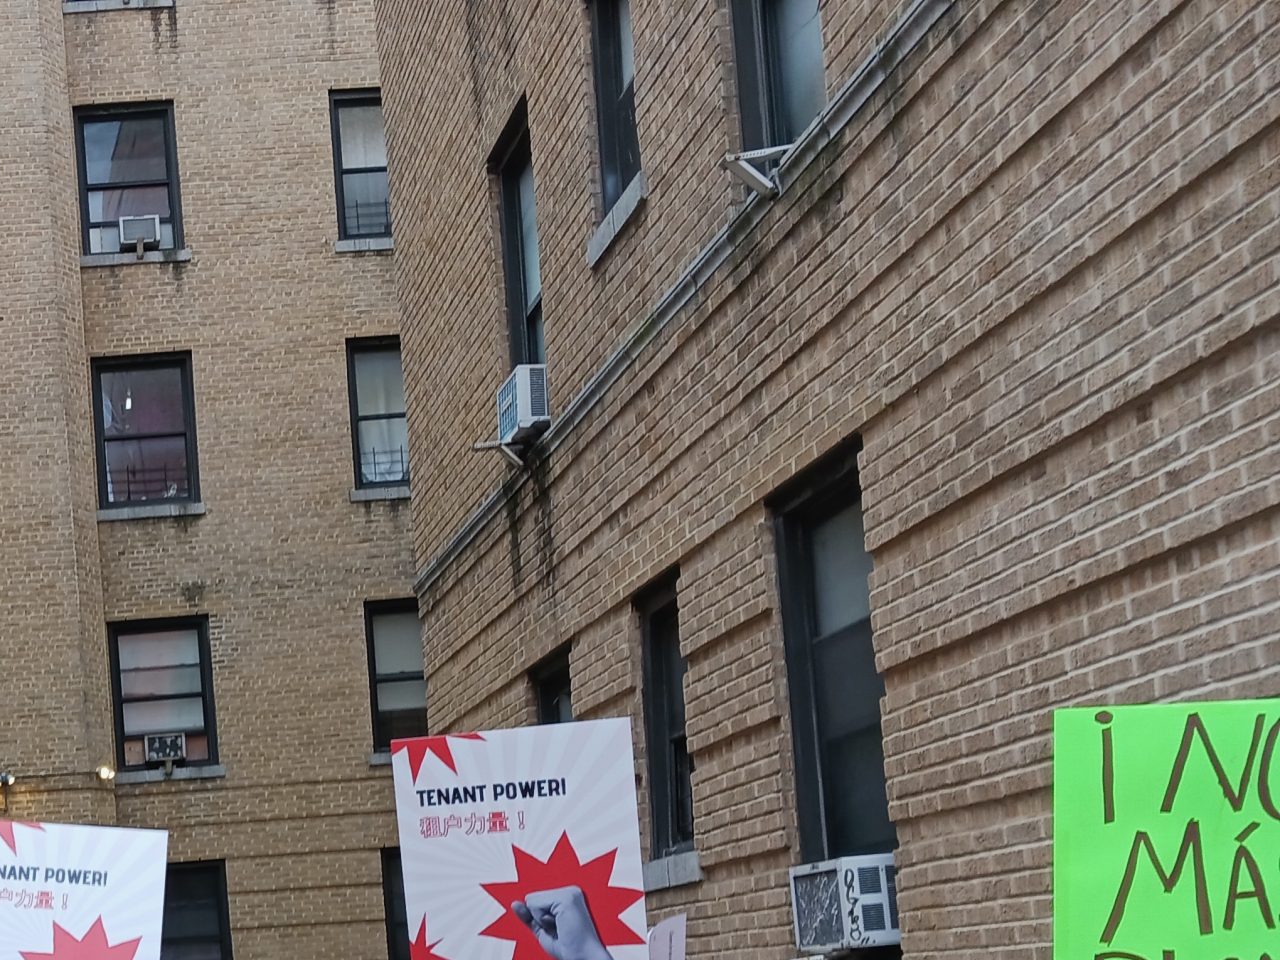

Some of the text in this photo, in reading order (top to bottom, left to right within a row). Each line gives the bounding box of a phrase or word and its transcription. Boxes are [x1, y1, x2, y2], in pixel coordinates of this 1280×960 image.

[416, 777, 567, 808] TENANT POWER!
[45, 867, 108, 887] POWER!
[1099, 817, 1280, 947] MÁ
